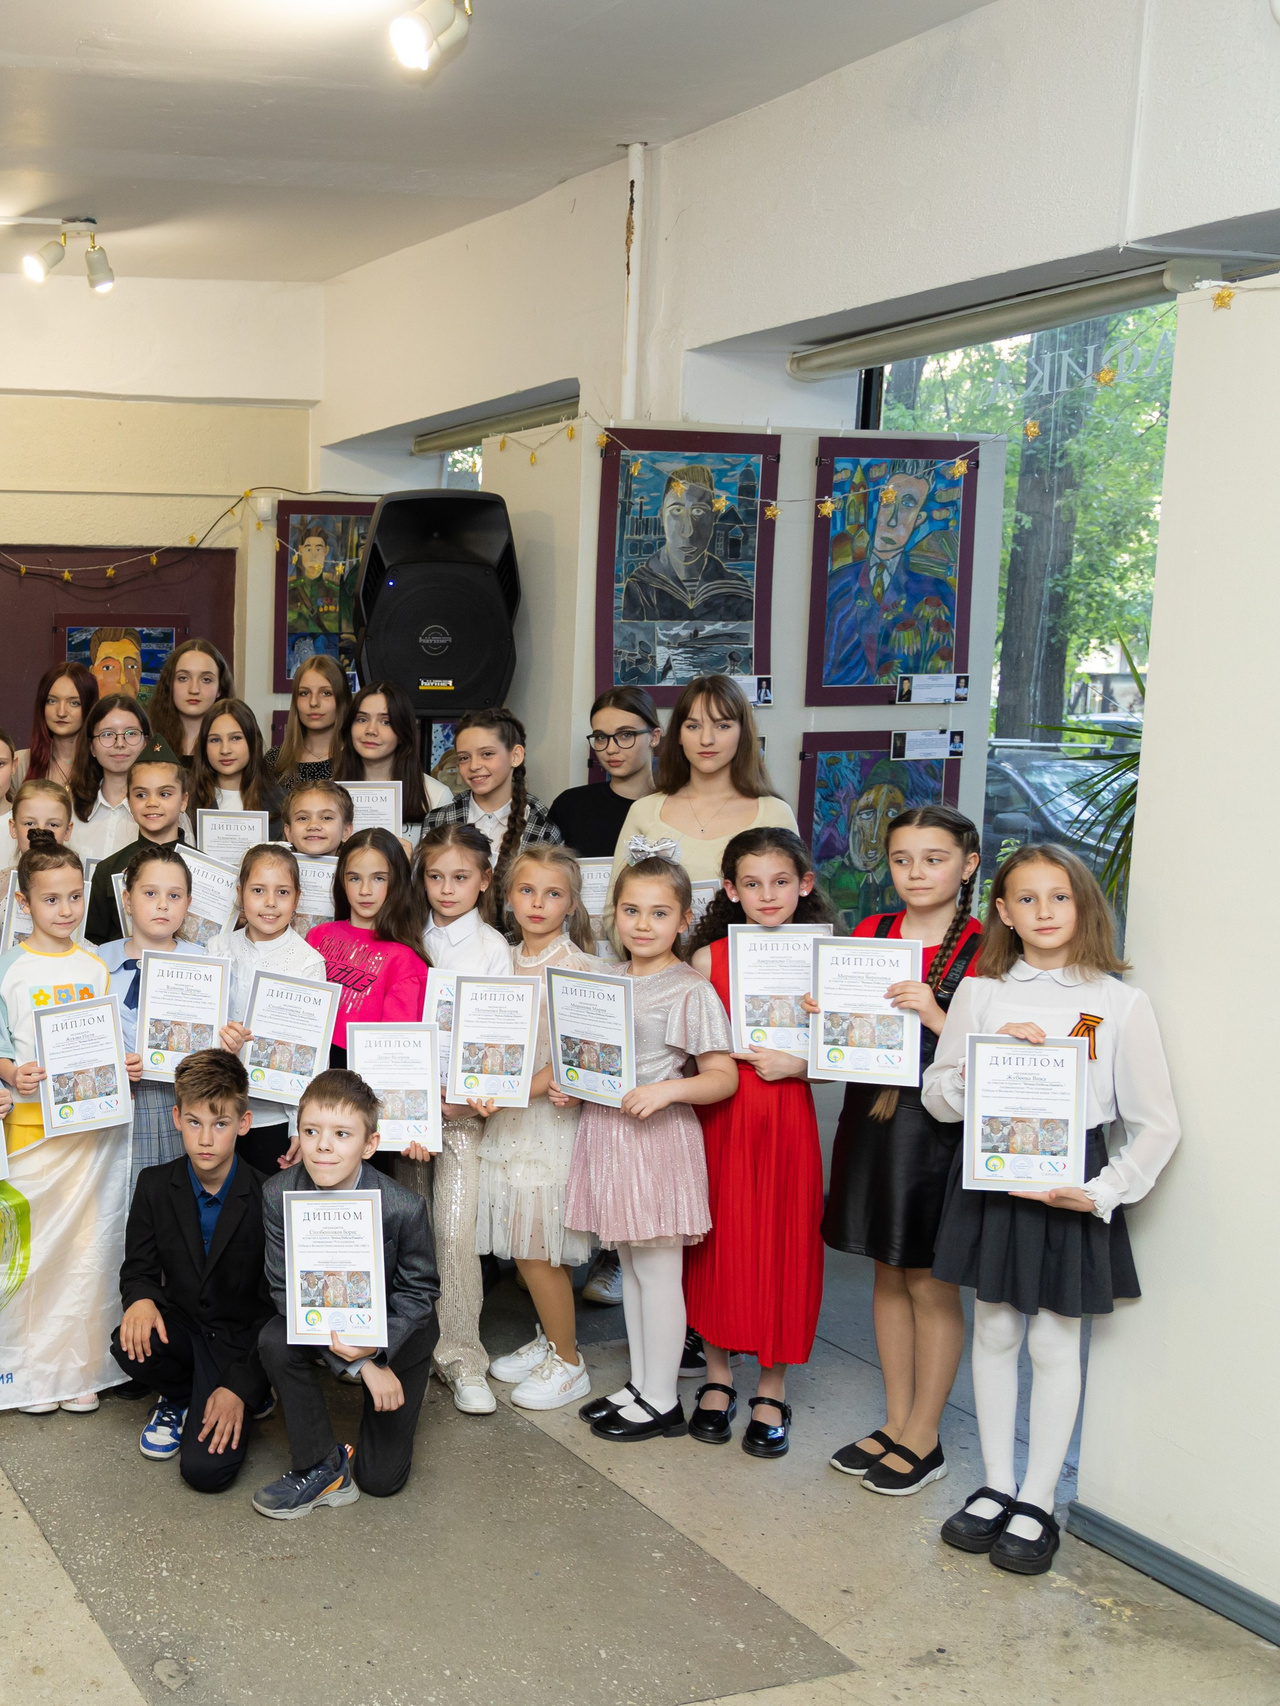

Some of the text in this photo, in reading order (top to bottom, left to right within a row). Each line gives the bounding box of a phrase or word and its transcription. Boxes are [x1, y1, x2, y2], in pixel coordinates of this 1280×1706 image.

[351, 795, 388, 803] ПЛОМ
[210, 823, 255, 832] ДИПЛОМ
[301, 870, 334, 879] ПЛОМ
[748, 942, 812, 952] ДИПЛОМ
[830, 956, 899, 968] ДИПЛОМ
[157, 969, 213, 982] ДИПЛОМ
[266, 988, 322, 1006] ДИПЛОМ
[470, 992, 525, 1002] ДИПЛОМ
[561, 986, 616, 1002] ДИПЛОМ
[51, 1015, 105, 1033] ДИПЛОМ
[364, 1040, 422, 1048] ДИПЛОМ
[989, 1056, 1065, 1068] ДИПЛОМ
[302, 1211, 363, 1222] ДИПЛОМ
